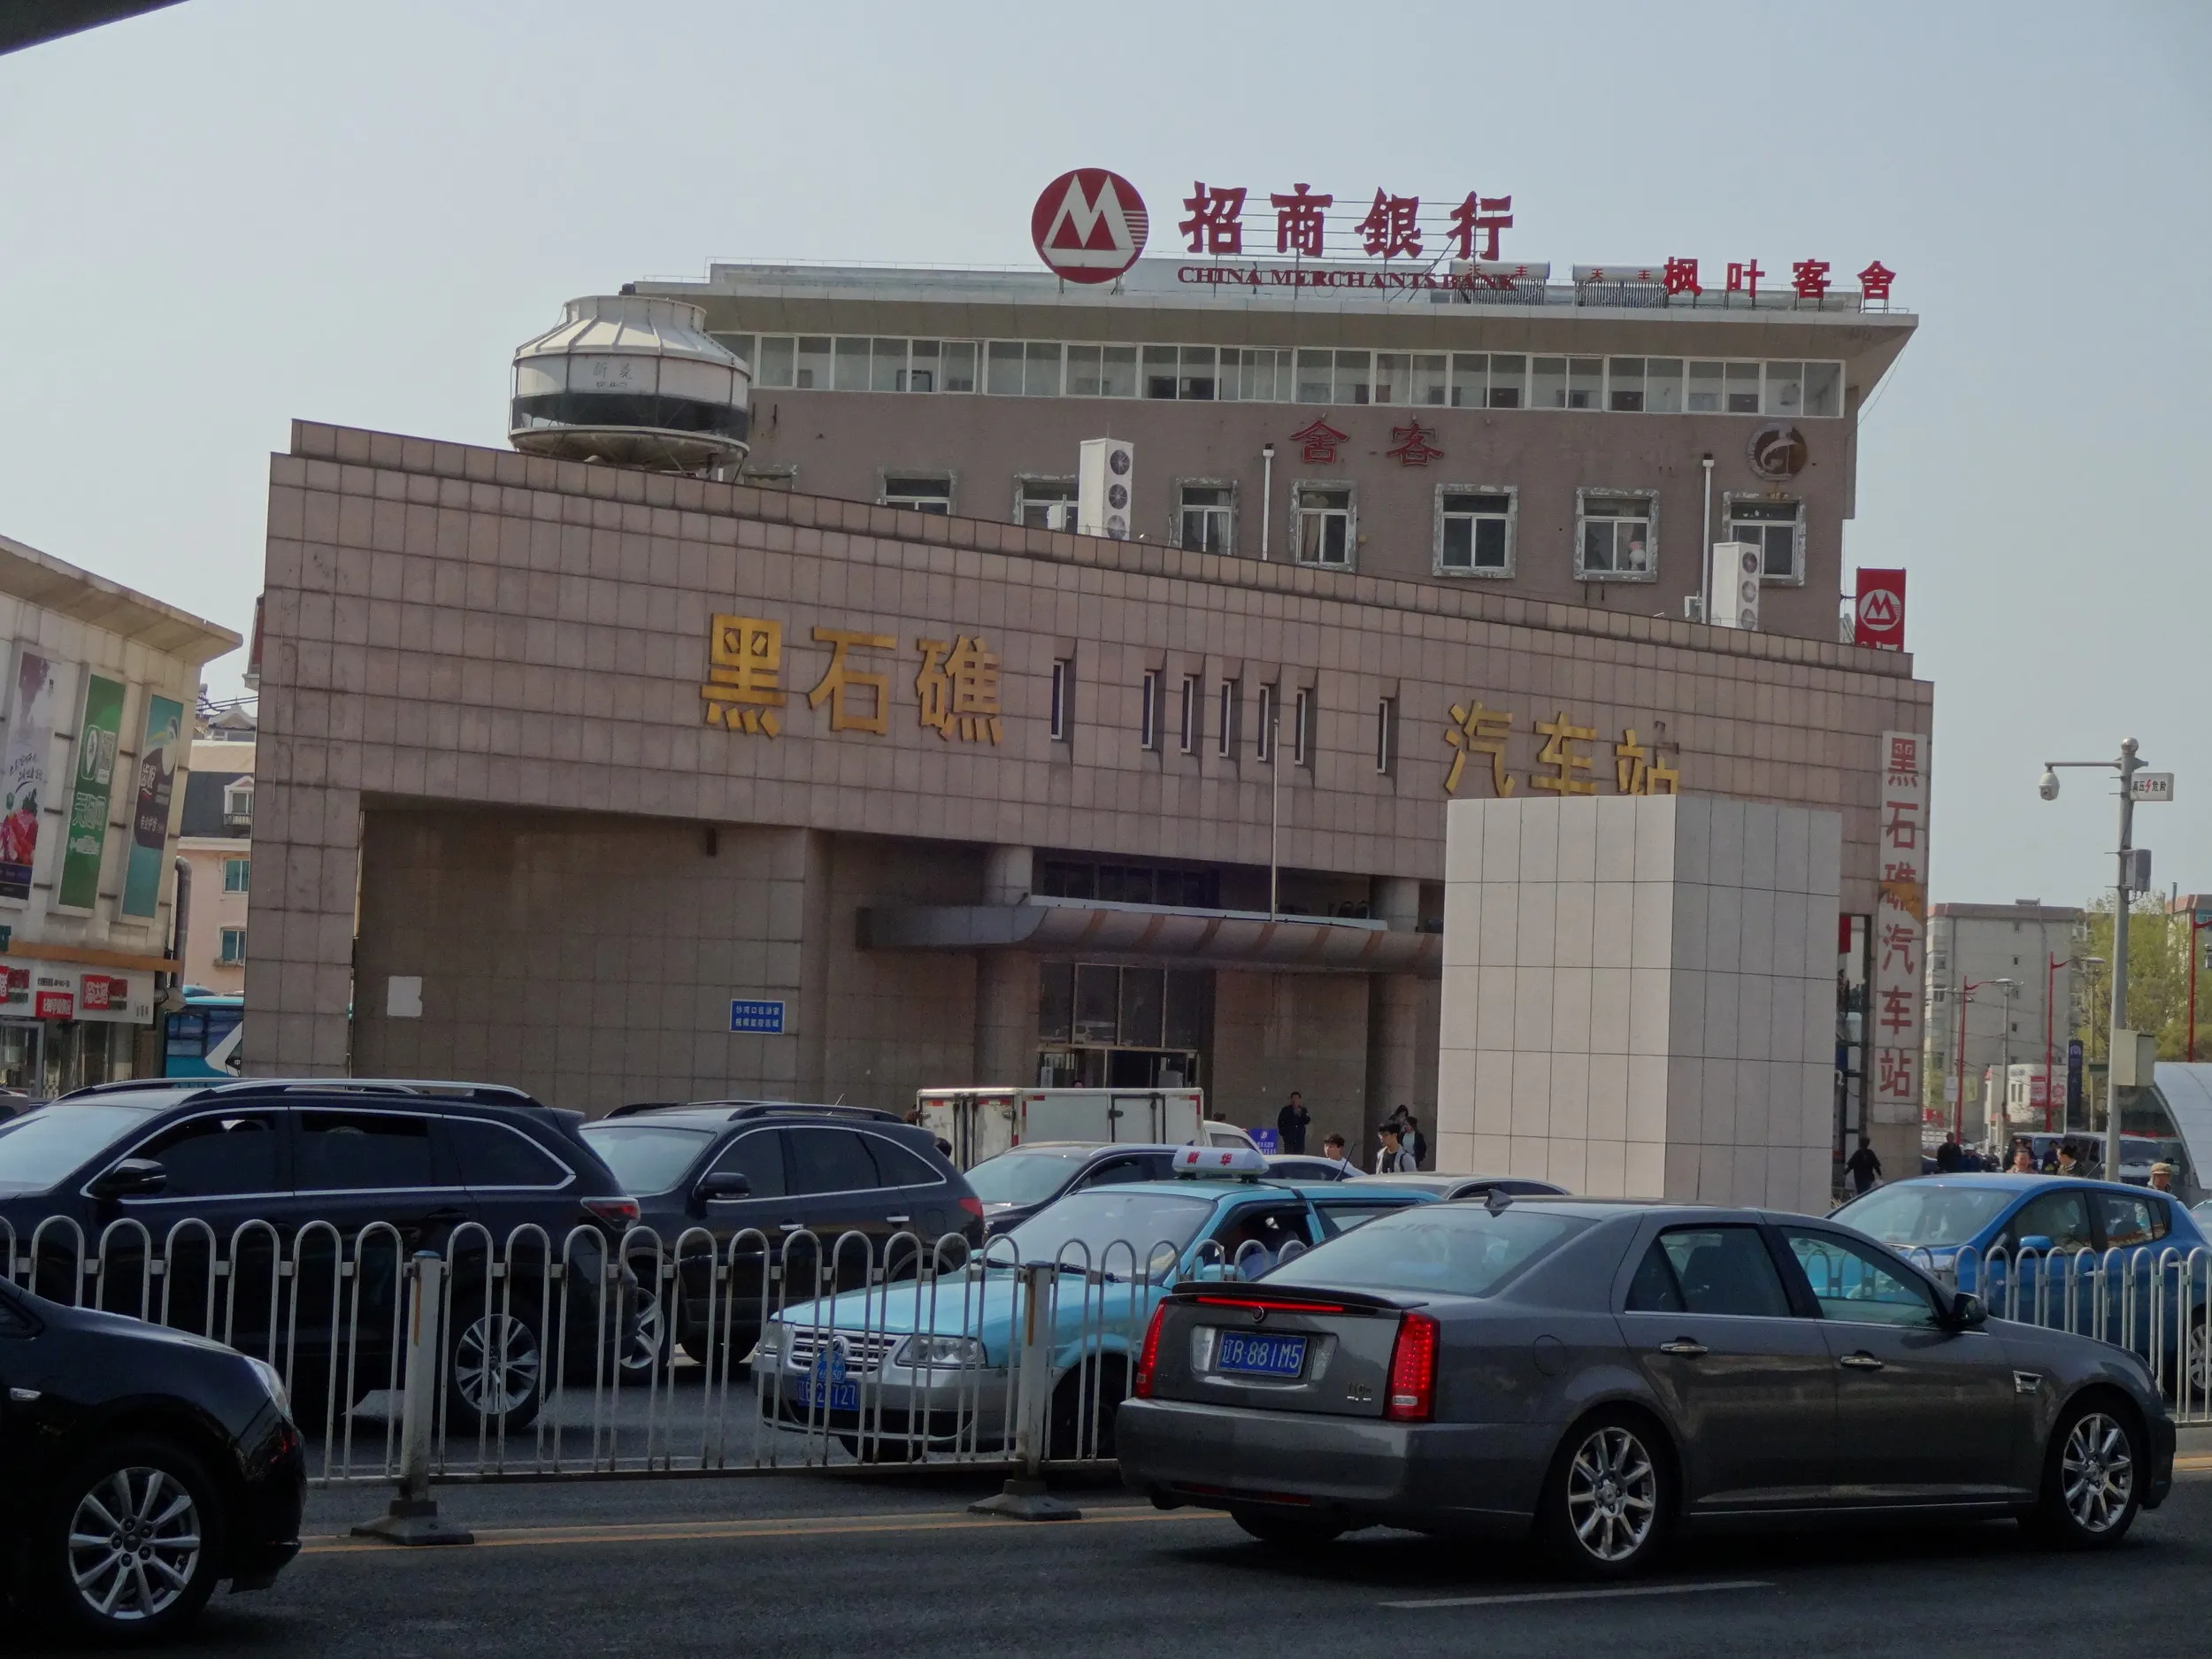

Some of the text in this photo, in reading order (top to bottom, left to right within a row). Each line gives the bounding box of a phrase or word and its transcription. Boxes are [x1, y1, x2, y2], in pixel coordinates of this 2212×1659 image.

[1178, 180, 1513, 263] 招商銀行
[1178, 266, 1519, 291] CHINA MERCHANTS BANK
[1663, 256, 1897, 300] 枫叶客舍
[700, 612, 1679, 796] 黑石礁 汽车站
